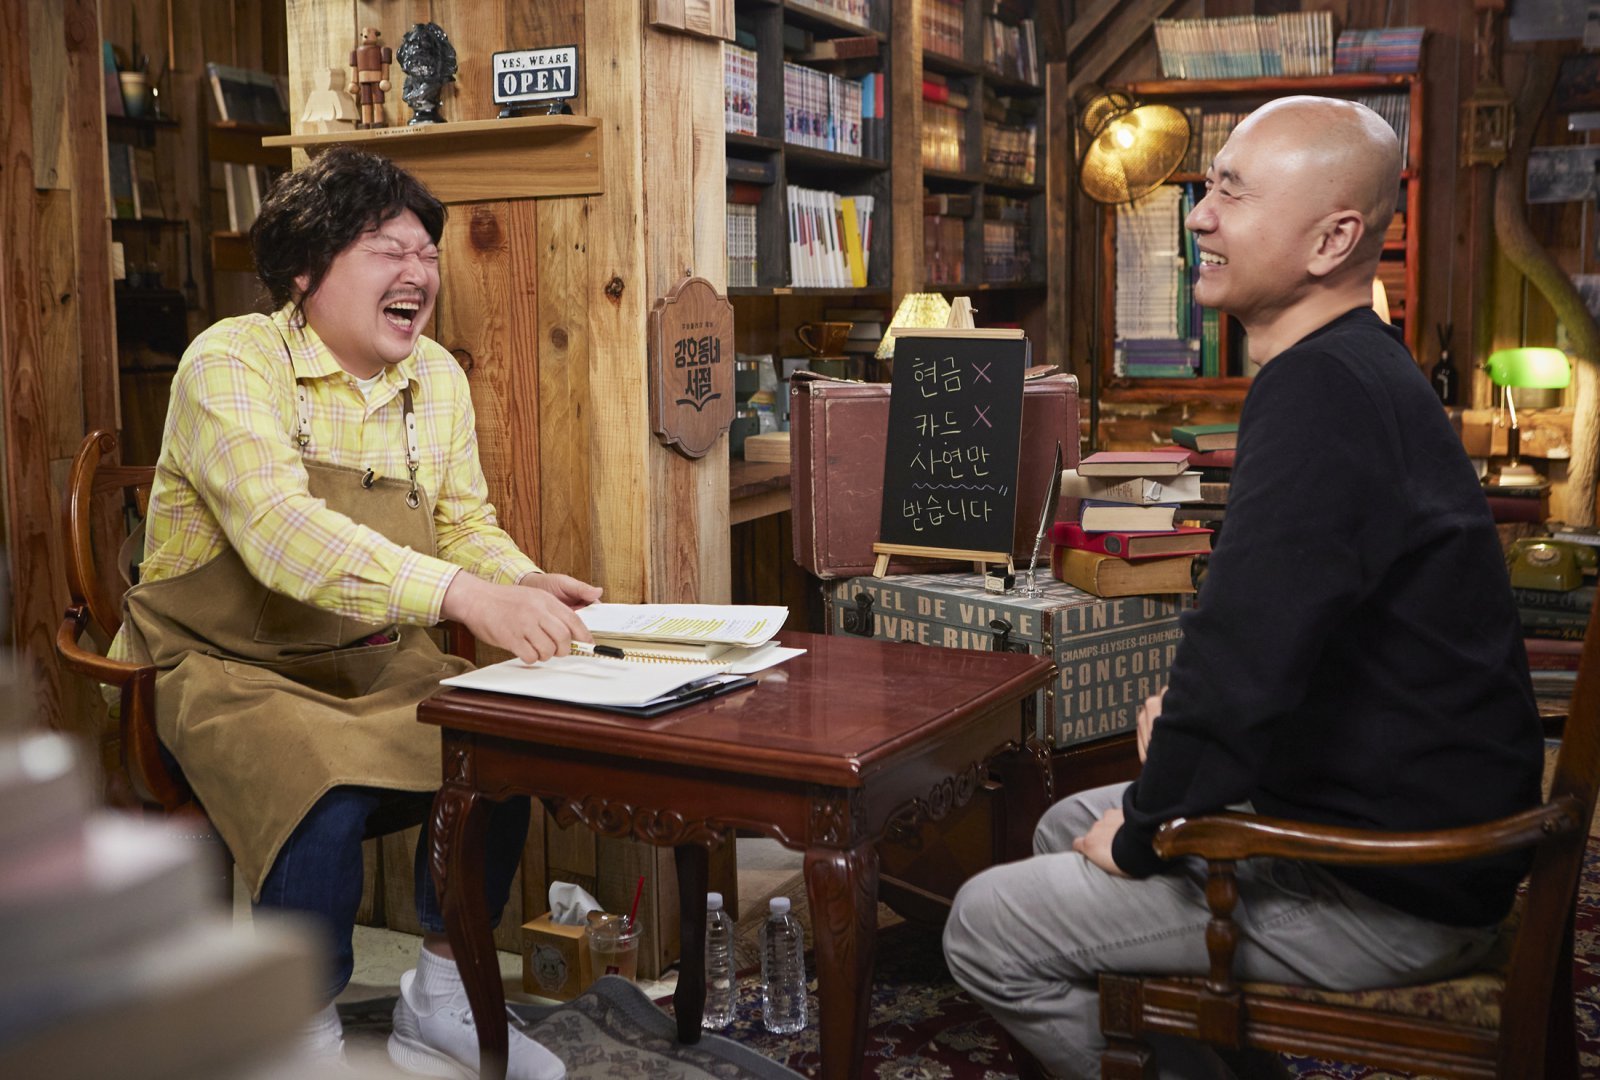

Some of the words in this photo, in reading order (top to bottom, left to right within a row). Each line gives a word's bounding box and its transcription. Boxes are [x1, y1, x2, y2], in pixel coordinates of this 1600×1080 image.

[502, 57, 525, 69] YES,
[529, 55, 544, 66] WE
[547, 53, 569, 65] ARE
[503, 69, 566, 95] OPEN
[674, 336, 721, 369] 강호동네
[685, 367, 712, 400] 서점
[912, 356, 962, 398] 현금
[913, 411, 962, 437] 카드
[910, 446, 990, 479] 사연만
[903, 494, 993, 531] 받습니다
[918, 595, 946, 619] DE
[959, 603, 1033, 636] VILLE
[1061, 600, 1125, 634] LINE
[1061, 644, 1177, 690] CONCORD
[1062, 672, 1170, 717] TUILERI
[1062, 708, 1128, 742] PALAIS
